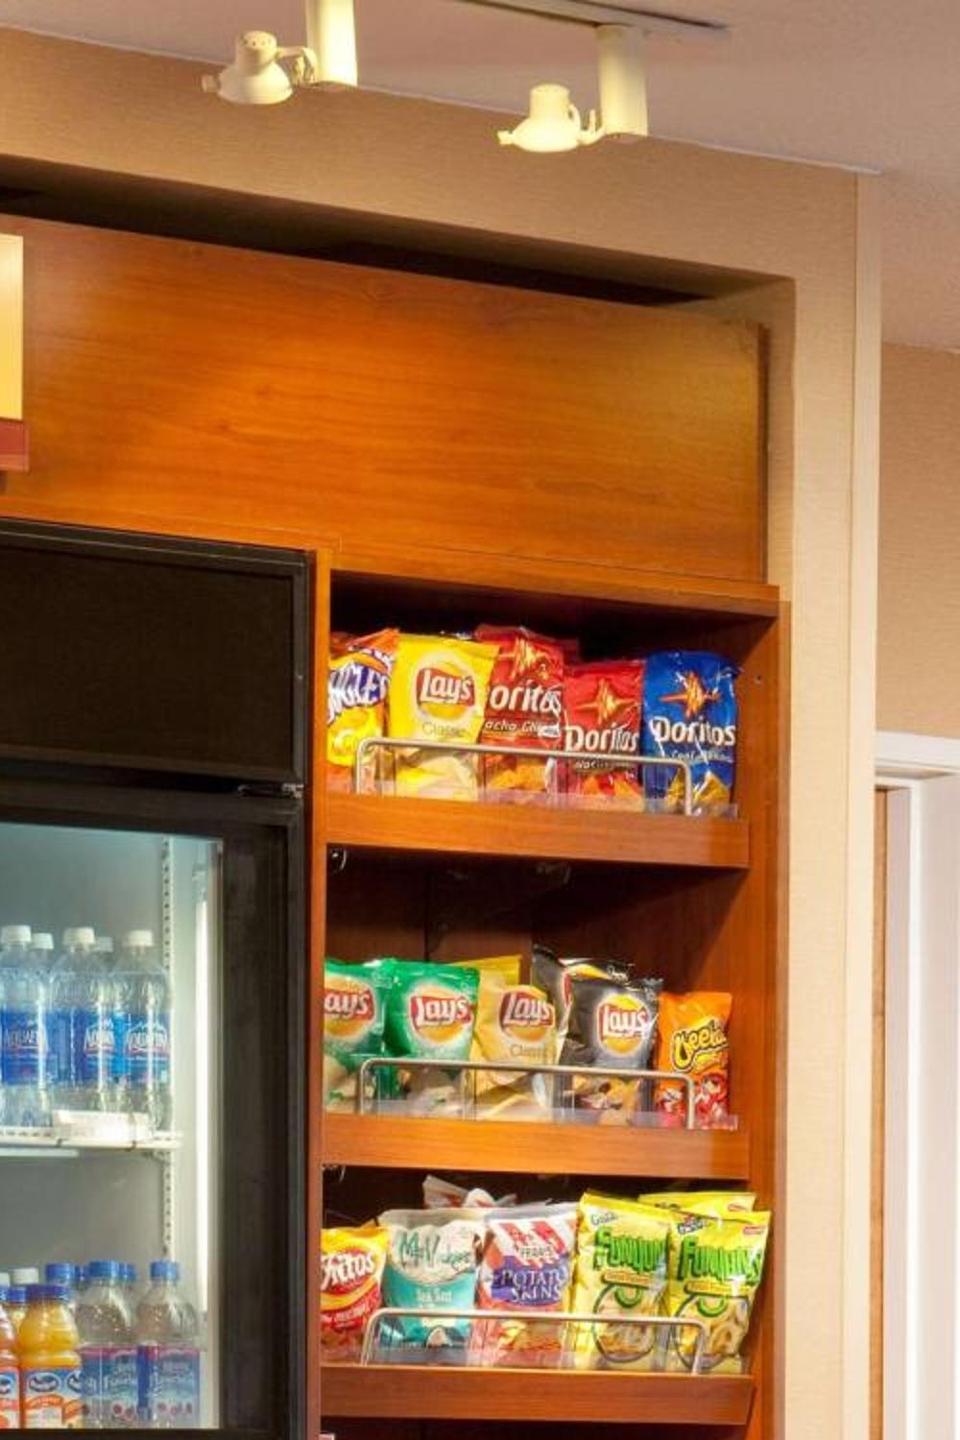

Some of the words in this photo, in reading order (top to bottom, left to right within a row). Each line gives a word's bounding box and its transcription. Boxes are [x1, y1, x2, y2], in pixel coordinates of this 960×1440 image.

[419, 668, 474, 705] Lay's
[491, 678, 562, 715] oritos
[484, 721, 517, 732] acho
[564, 722, 639, 752] Doritos
[650, 714, 736, 747] Doritos
[324, 989, 371, 1018] ay's
[415, 995, 470, 1027] Lay's
[503, 992, 551, 1026] Lay's
[602, 1002, 648, 1039] Lay's
[593, 1225, 668, 1273] FUNYUN
[321, 1251, 375, 1291] Fritos
[501, 1269, 568, 1286] POTATO
[511, 1284, 563, 1301] SKINS
